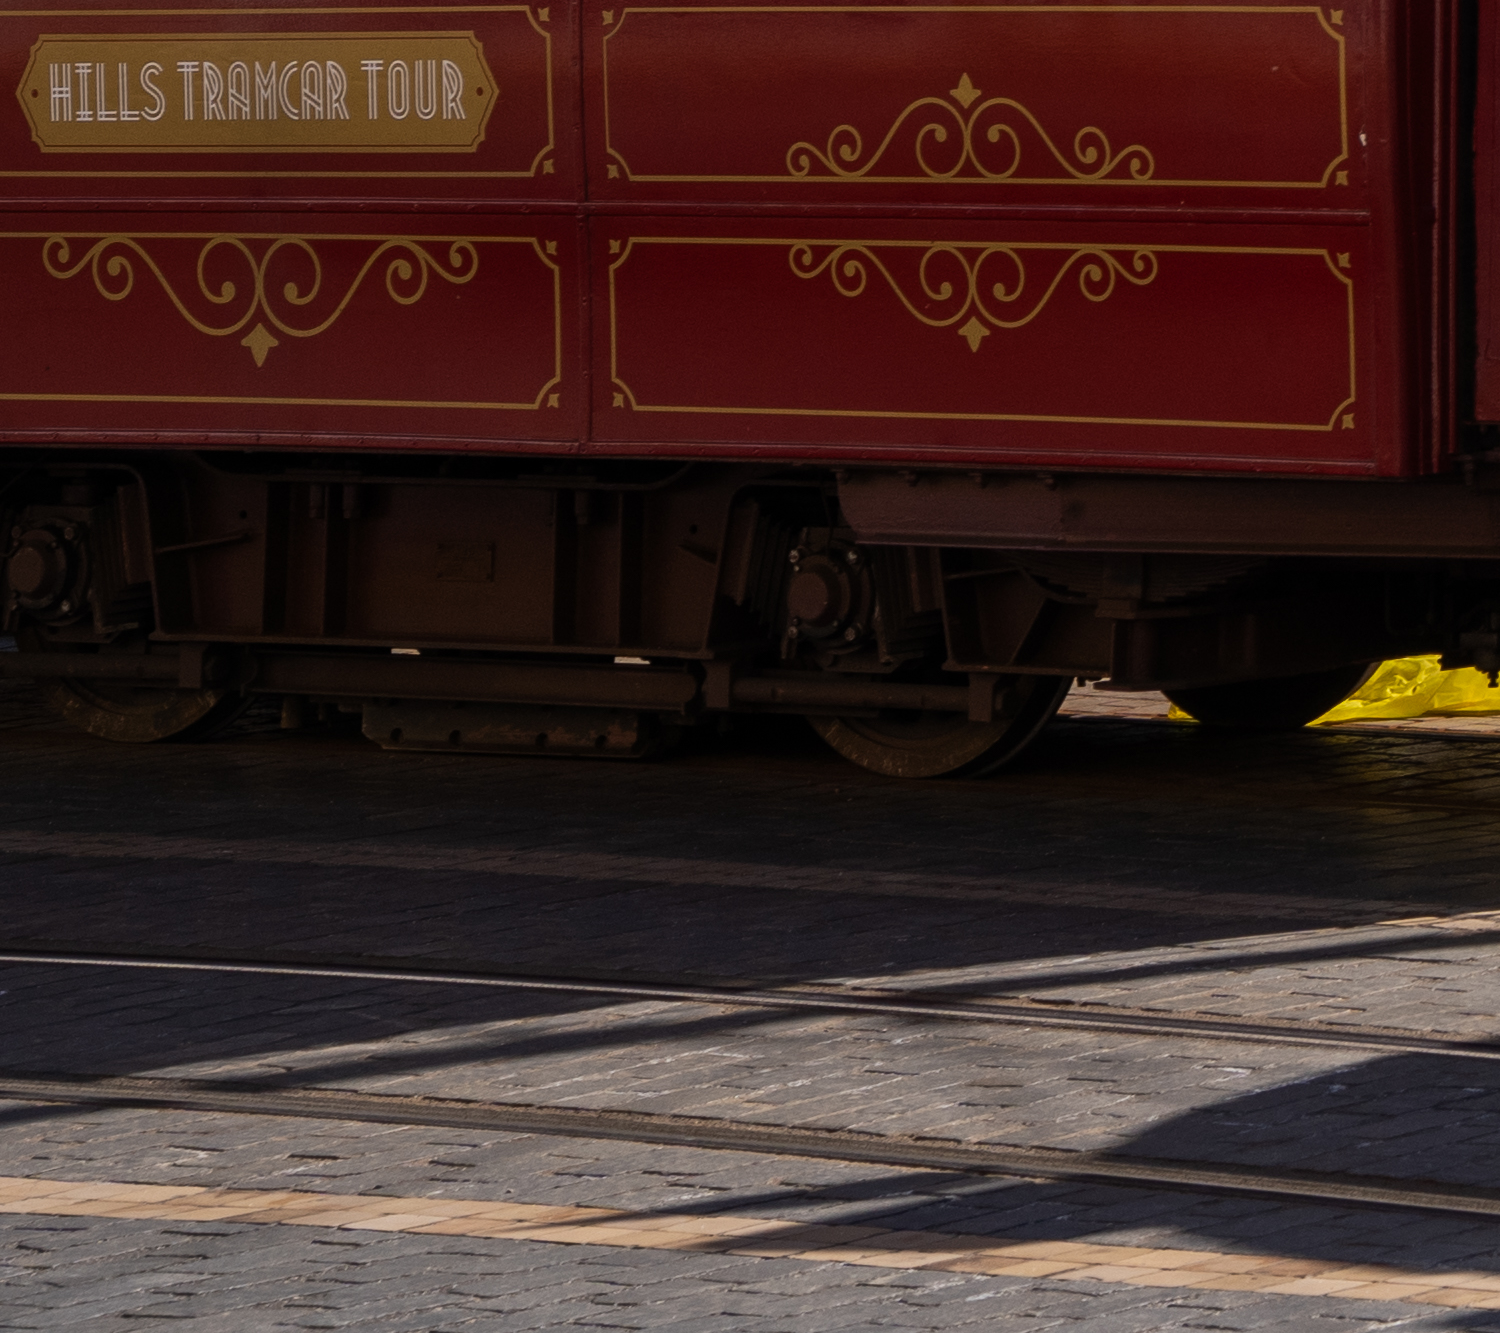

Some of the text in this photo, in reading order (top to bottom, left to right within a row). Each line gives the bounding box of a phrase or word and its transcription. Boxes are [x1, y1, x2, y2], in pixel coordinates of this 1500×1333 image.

[49, 59, 466, 122] HILLS TRAMCAR TOUR
